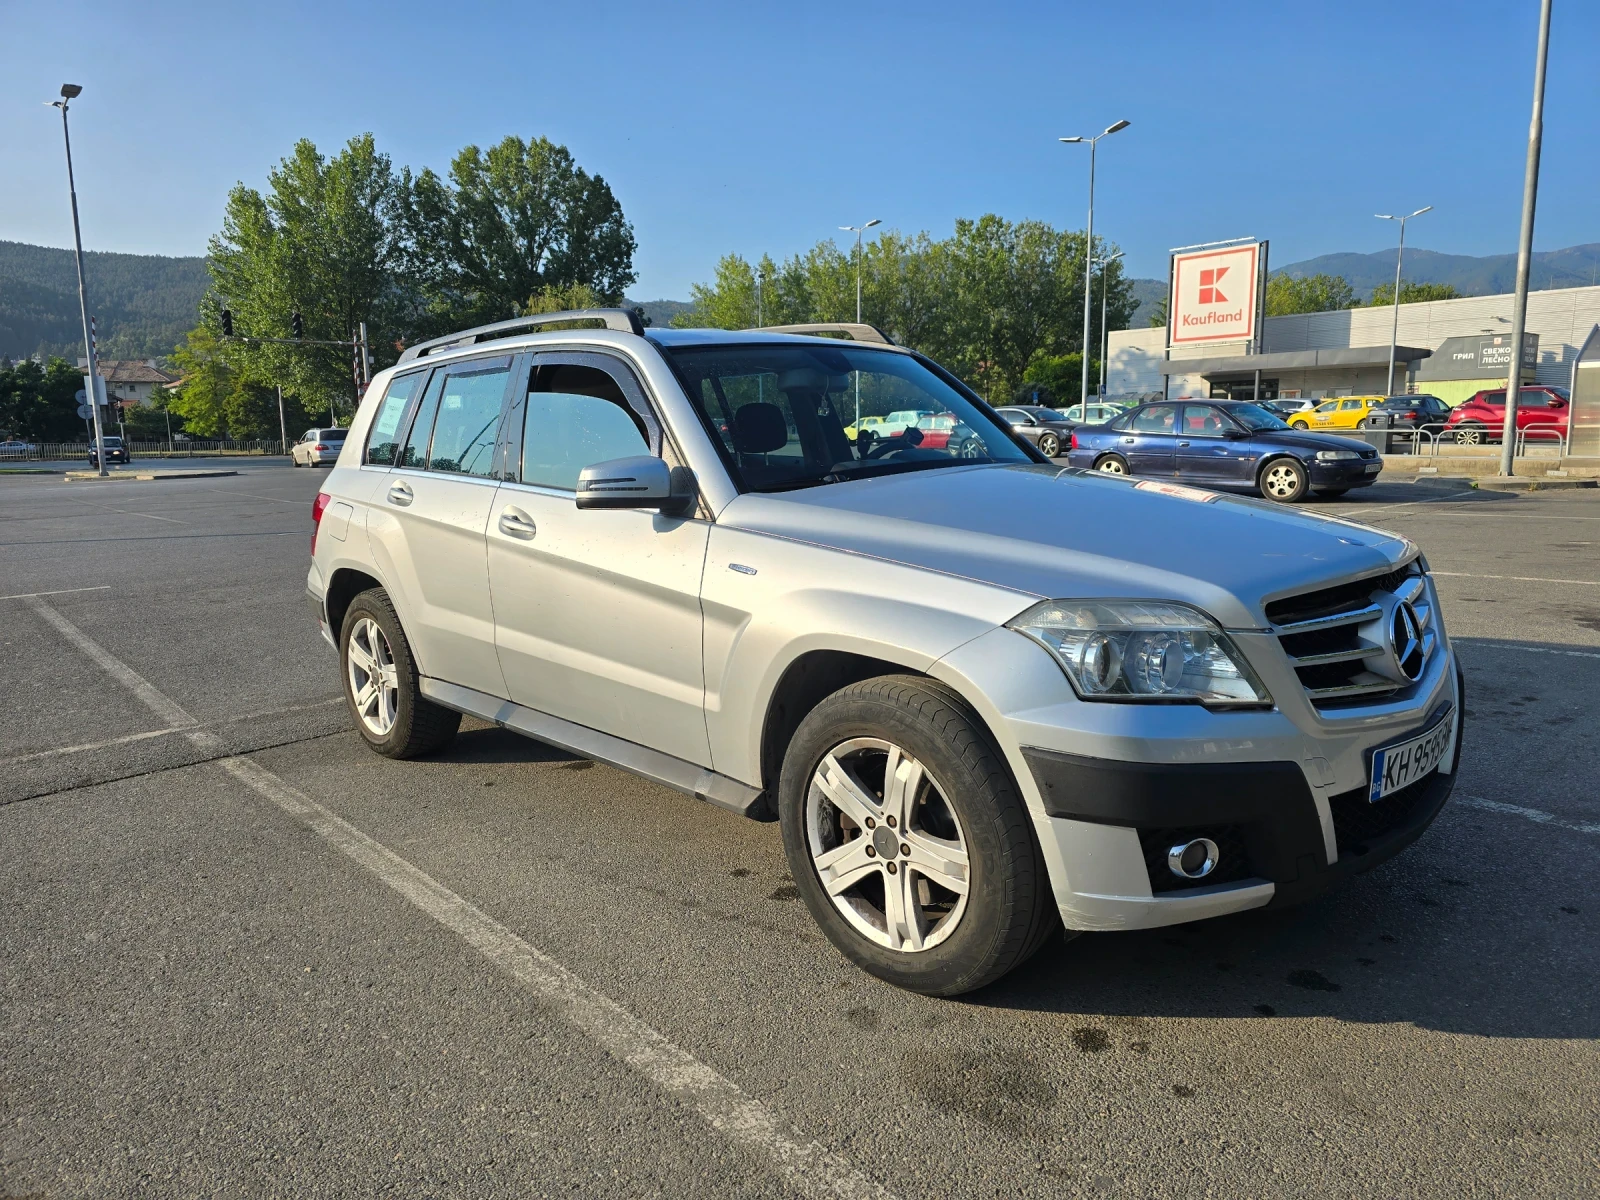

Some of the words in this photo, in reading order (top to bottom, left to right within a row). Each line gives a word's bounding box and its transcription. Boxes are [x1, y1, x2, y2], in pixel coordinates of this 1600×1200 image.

[1183, 309, 1243, 326] Kaufland
[1453, 352, 1474, 360] ГРИЛ
[1482, 347, 1512, 355] СВЕЖО
[1482, 356, 1511, 364] ЛЕСНО
[1384, 747, 1412, 791] KH
[1372, 782, 1381, 794] BG
